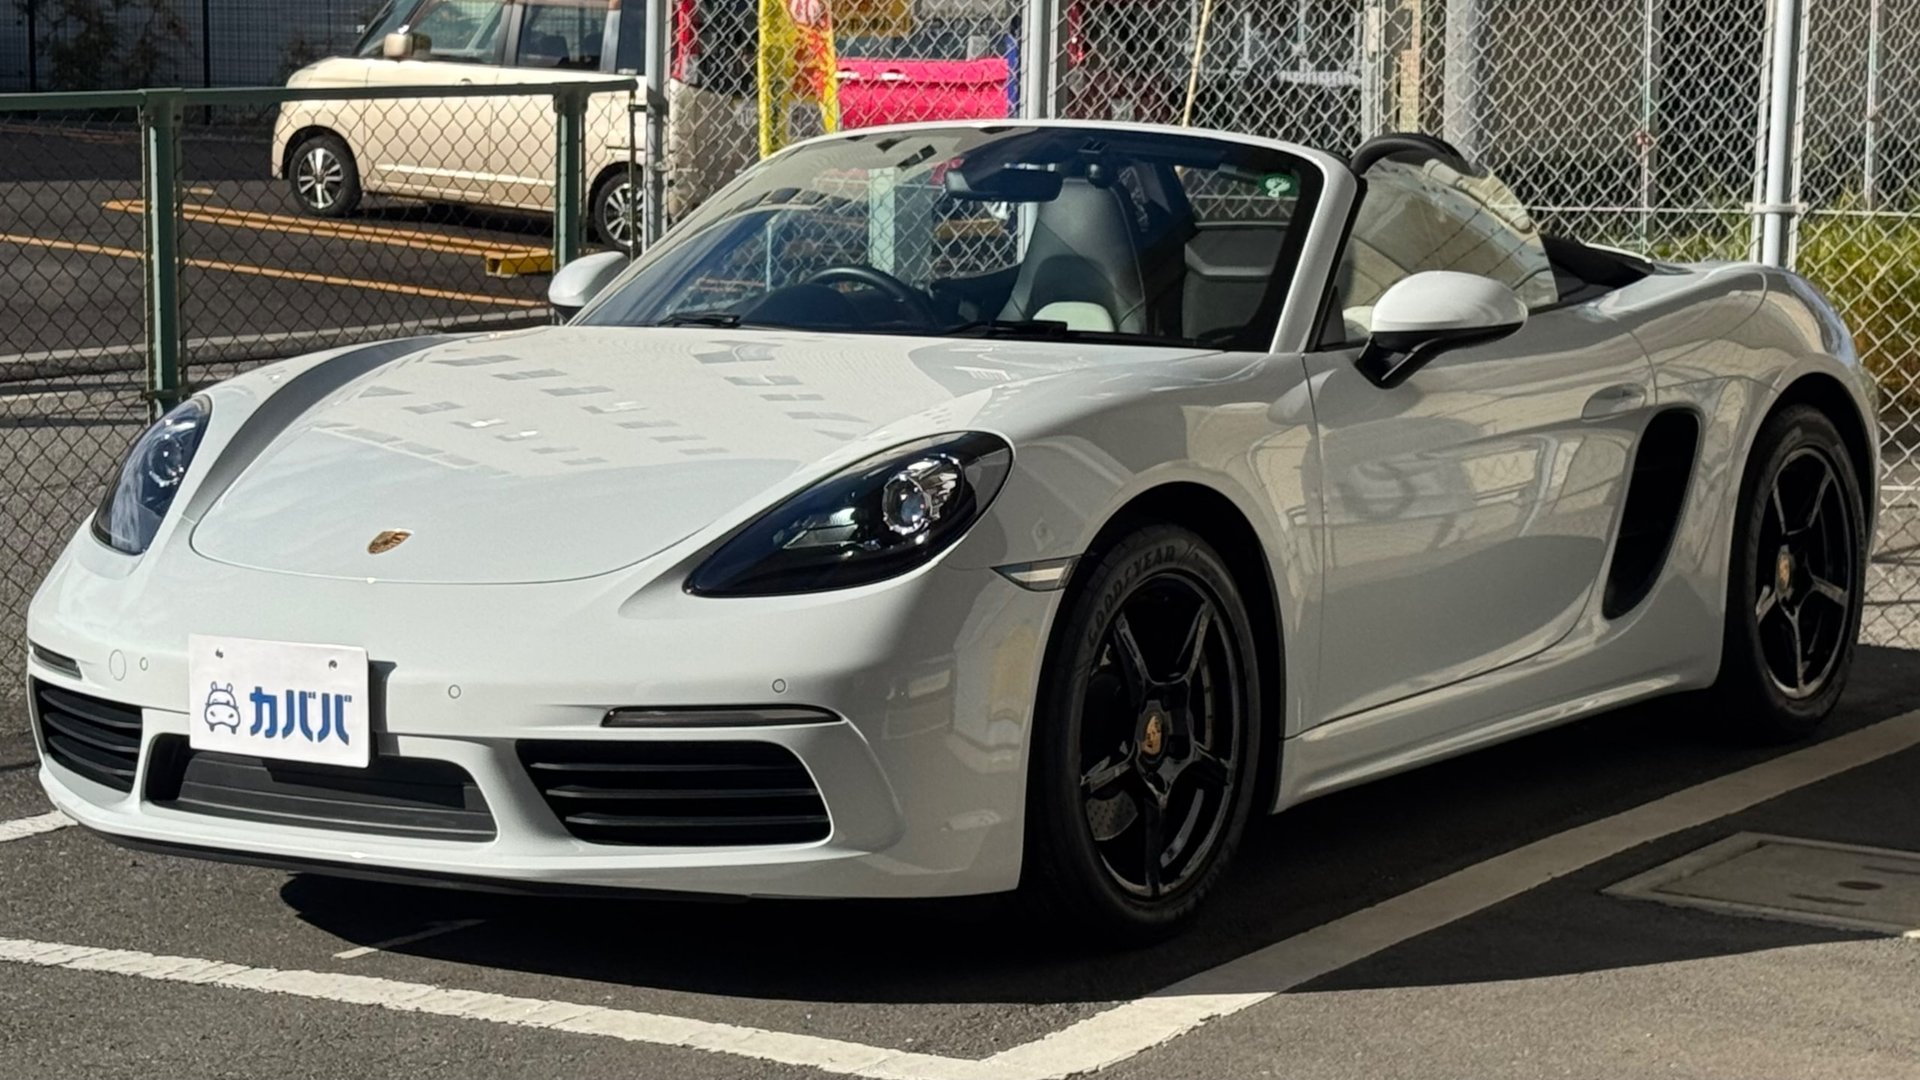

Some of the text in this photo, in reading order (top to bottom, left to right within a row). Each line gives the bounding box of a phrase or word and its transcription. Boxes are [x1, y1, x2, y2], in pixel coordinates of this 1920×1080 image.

[1088, 545, 1176, 647] GOODYEAR
[250, 686, 352, 745] カババ
